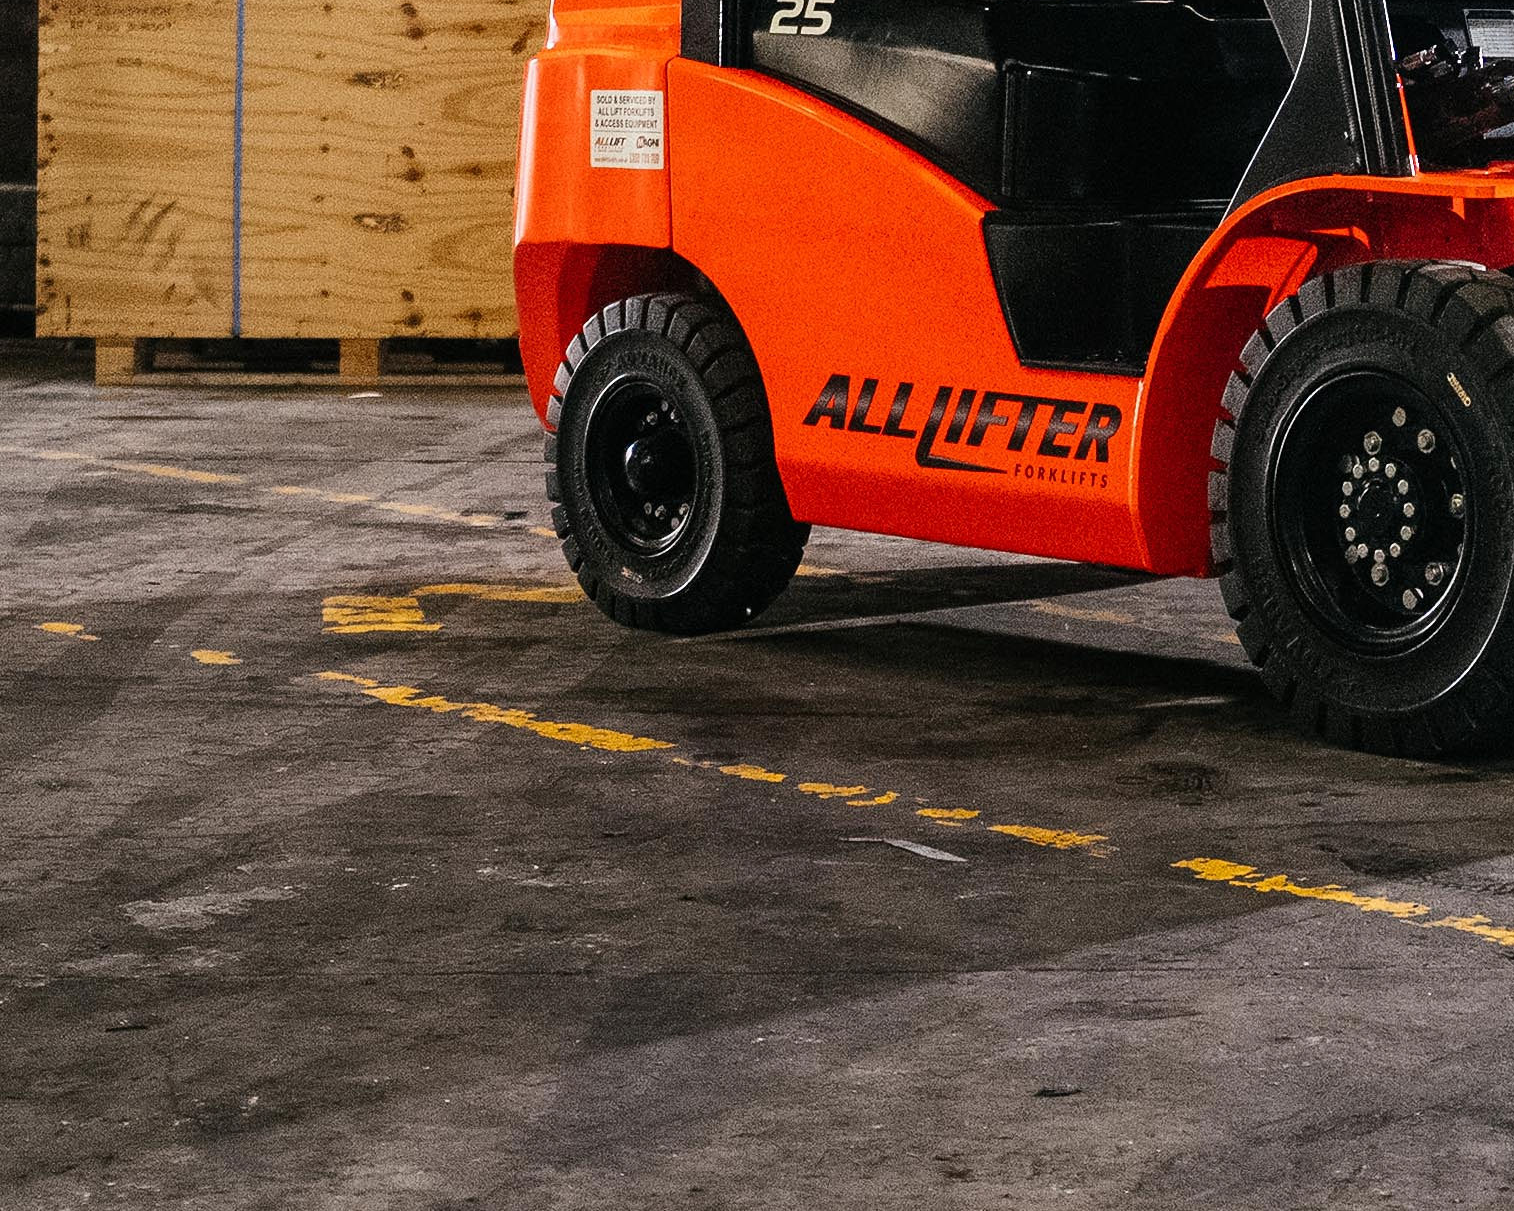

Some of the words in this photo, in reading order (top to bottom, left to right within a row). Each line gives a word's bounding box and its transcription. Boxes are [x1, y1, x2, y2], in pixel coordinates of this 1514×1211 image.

[596, 95, 613, 105] SOLD
[619, 95, 647, 105] SERVICED
[648, 96, 656, 105] BY
[598, 107, 609, 116] ALL
[610, 108, 623, 116] LIFT
[623, 108, 655, 117] FORKLIFTS
[600, 119, 624, 128] ACCESS
[625, 120, 658, 129] EQUIPMENT
[1014, 463, 1109, 489] FORKLIFTS
